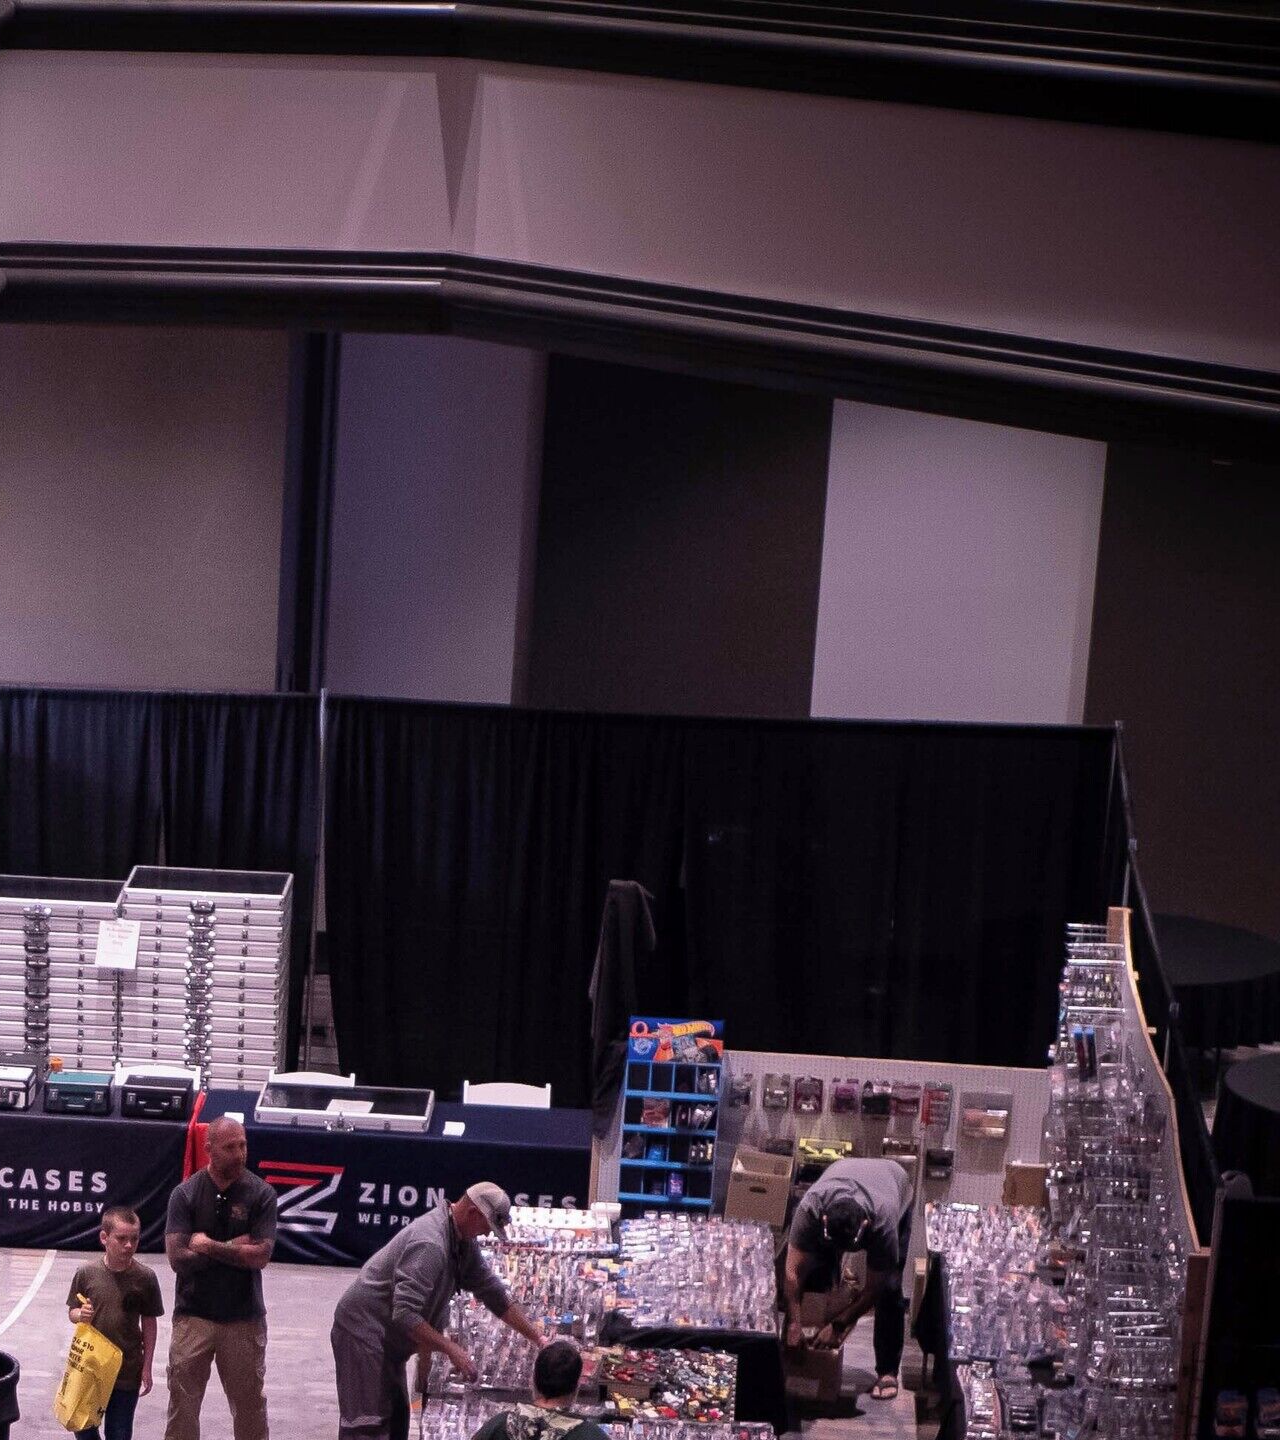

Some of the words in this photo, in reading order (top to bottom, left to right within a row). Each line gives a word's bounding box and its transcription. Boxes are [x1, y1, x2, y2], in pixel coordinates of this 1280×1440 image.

[358, 1182, 445, 1208] ZION
[9, 1198, 40, 1211] THE
[48, 1201, 104, 1213] HOBBY
[358, 1213, 381, 1224] WE
[82, 1341, 95, 1352] $10
